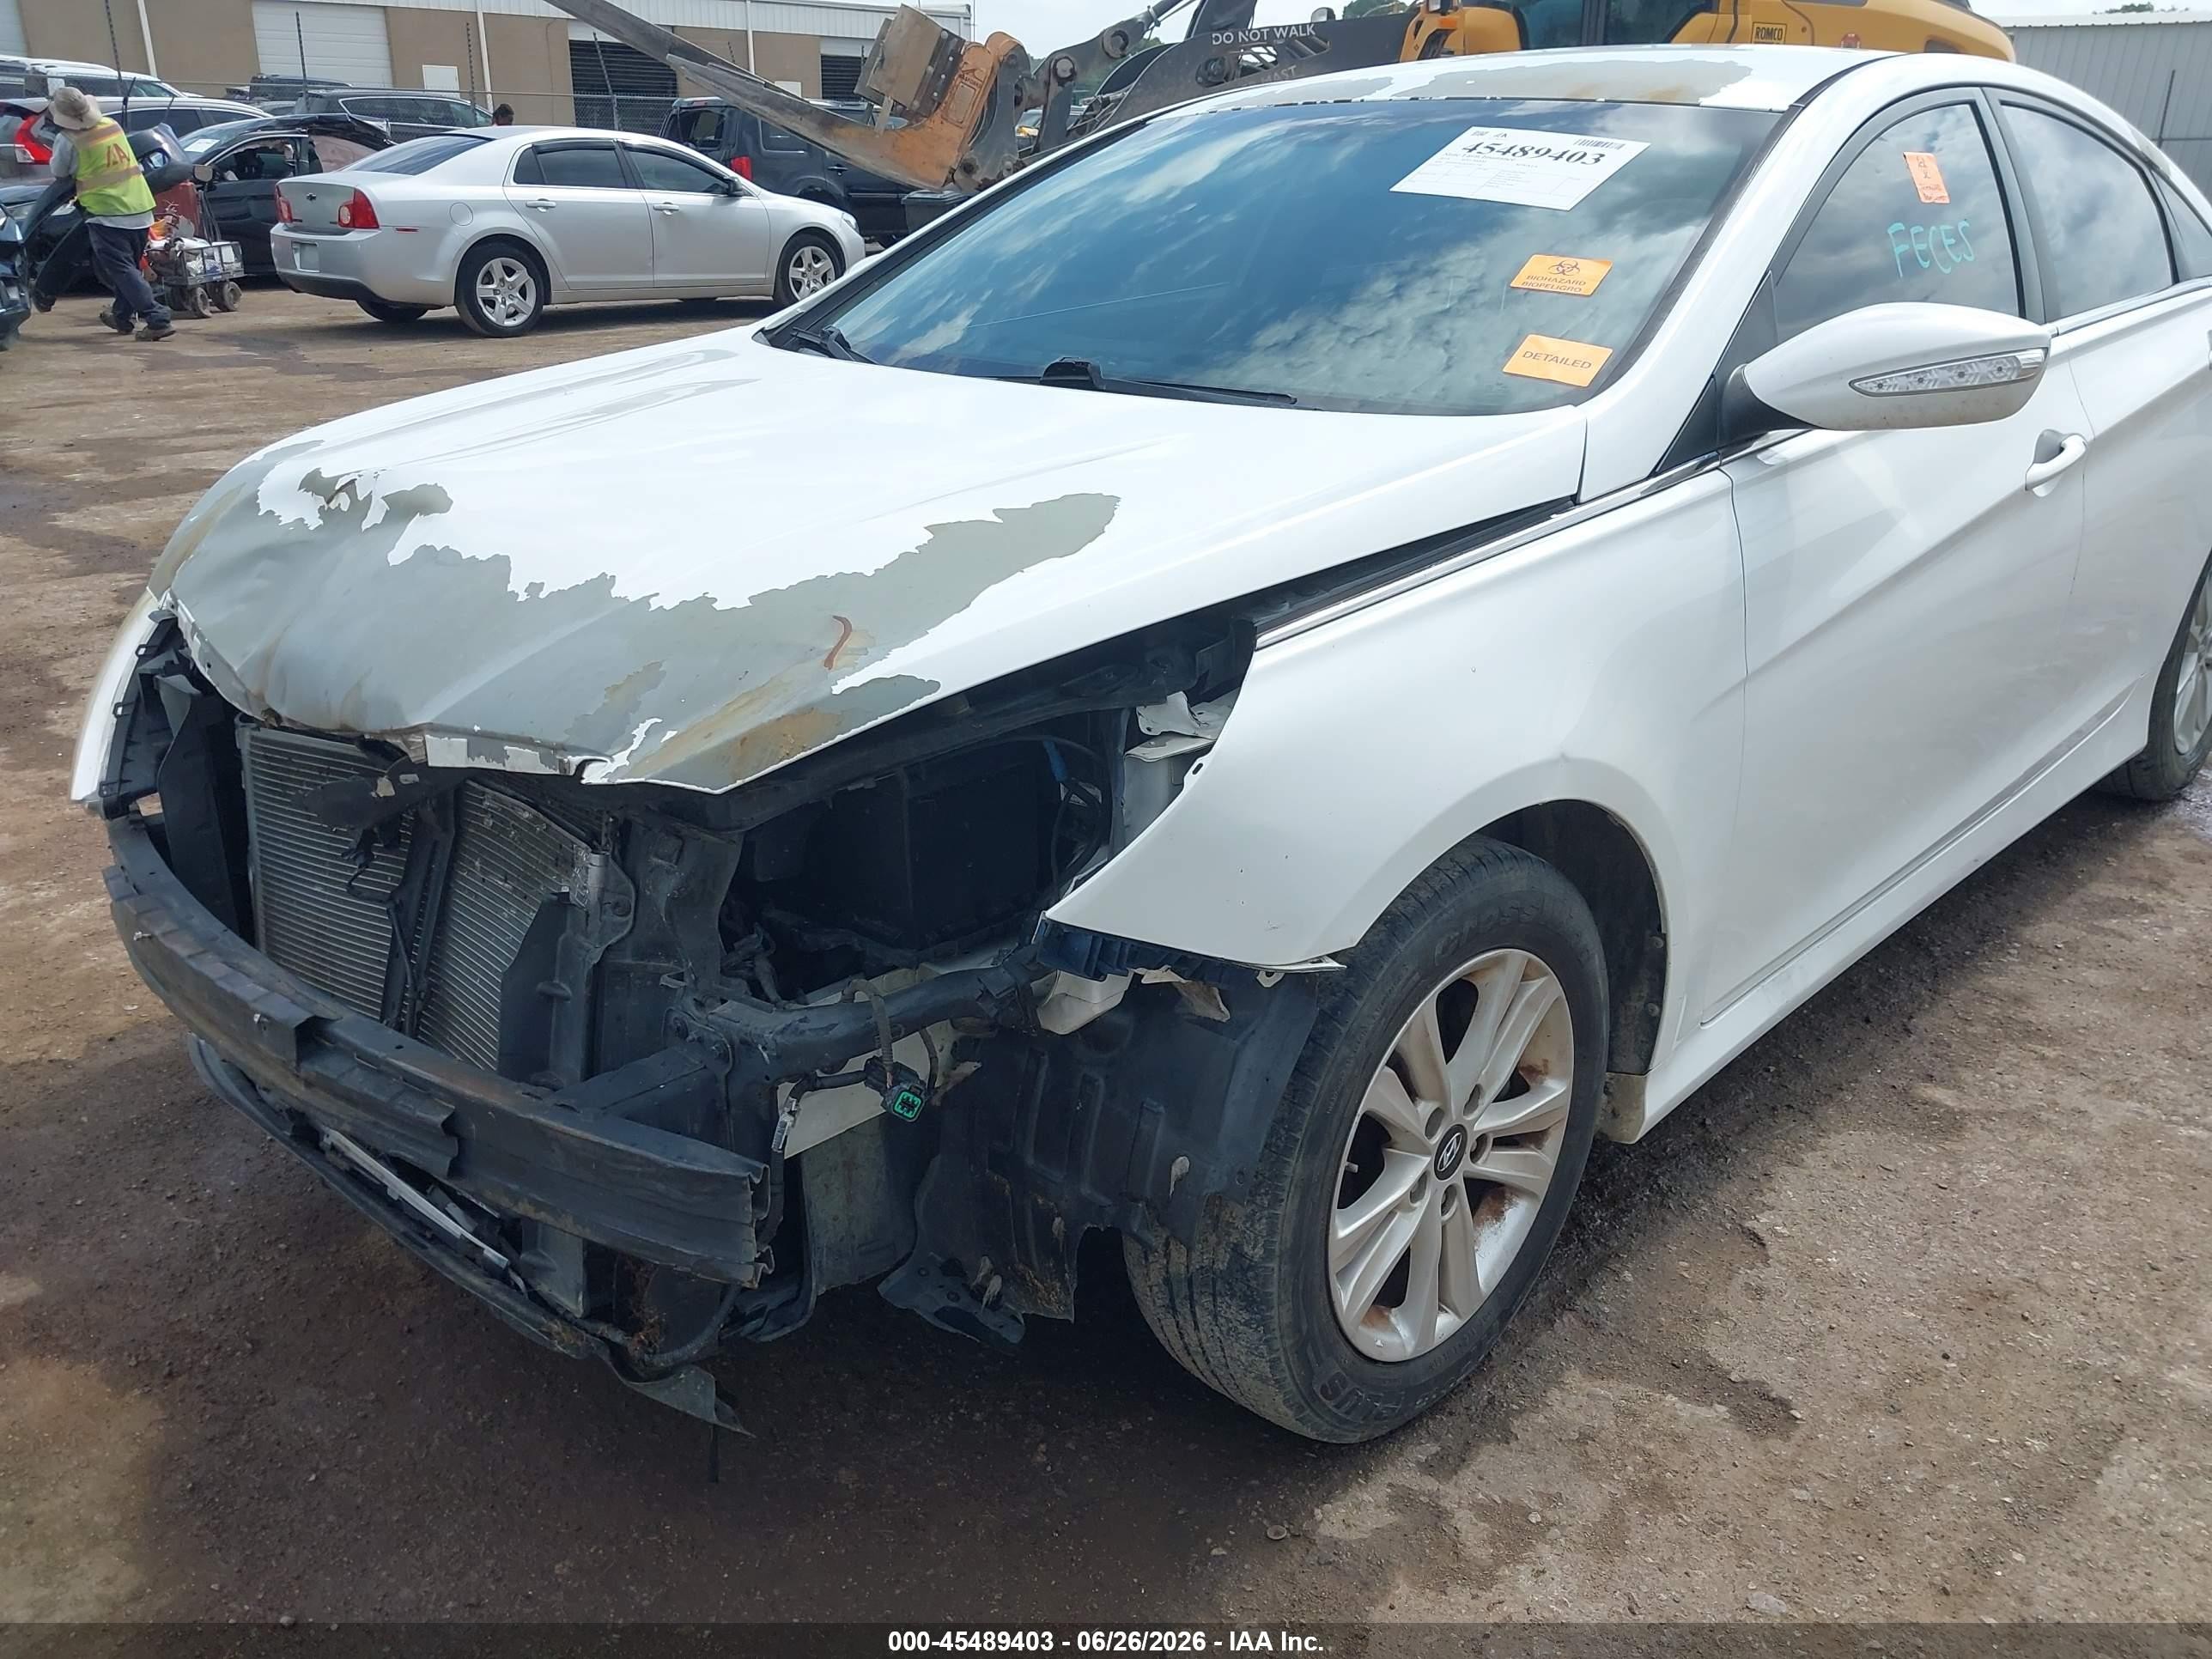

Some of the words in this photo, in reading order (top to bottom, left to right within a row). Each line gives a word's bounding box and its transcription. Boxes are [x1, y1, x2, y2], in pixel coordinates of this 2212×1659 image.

[1212, 32, 1234, 46] DO
[1238, 28, 1270, 43] NOT
[1273, 23, 1316, 39] WALK
[1754, 27, 1784, 41] ROMCO
[1462, 141, 1606, 166] 45489403
[1887, 220, 1976, 278] FECES
[1521, 280, 1582, 293] BIOPELIGRO
[1525, 274, 1587, 287] BIOHAZARD
[1522, 349, 1594, 370] DETAILED
